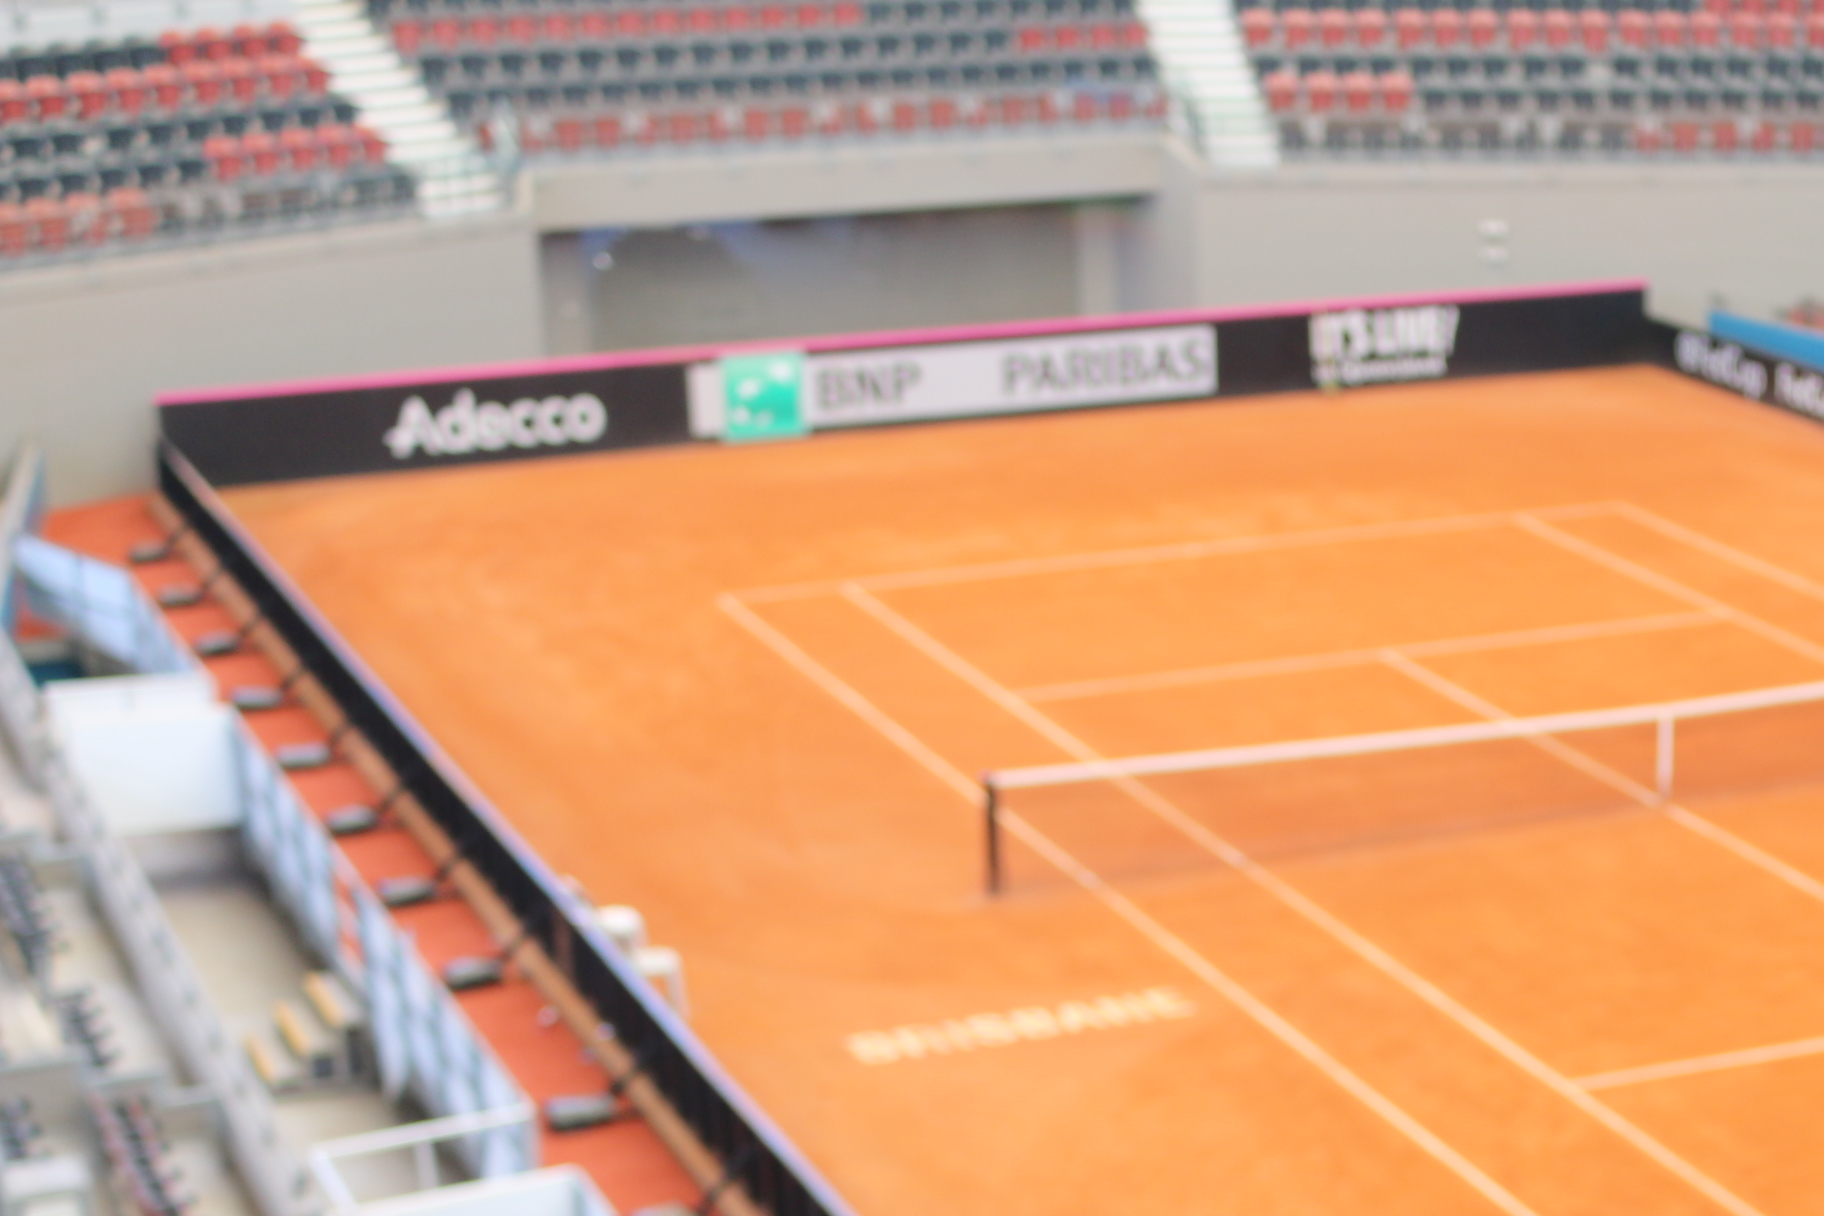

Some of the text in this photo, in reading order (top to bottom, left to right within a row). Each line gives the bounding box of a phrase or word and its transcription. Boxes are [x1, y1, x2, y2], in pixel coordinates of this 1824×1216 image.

[815, 337, 1210, 413] BNP PARIBAS
[383, 388, 607, 460] Adecco
